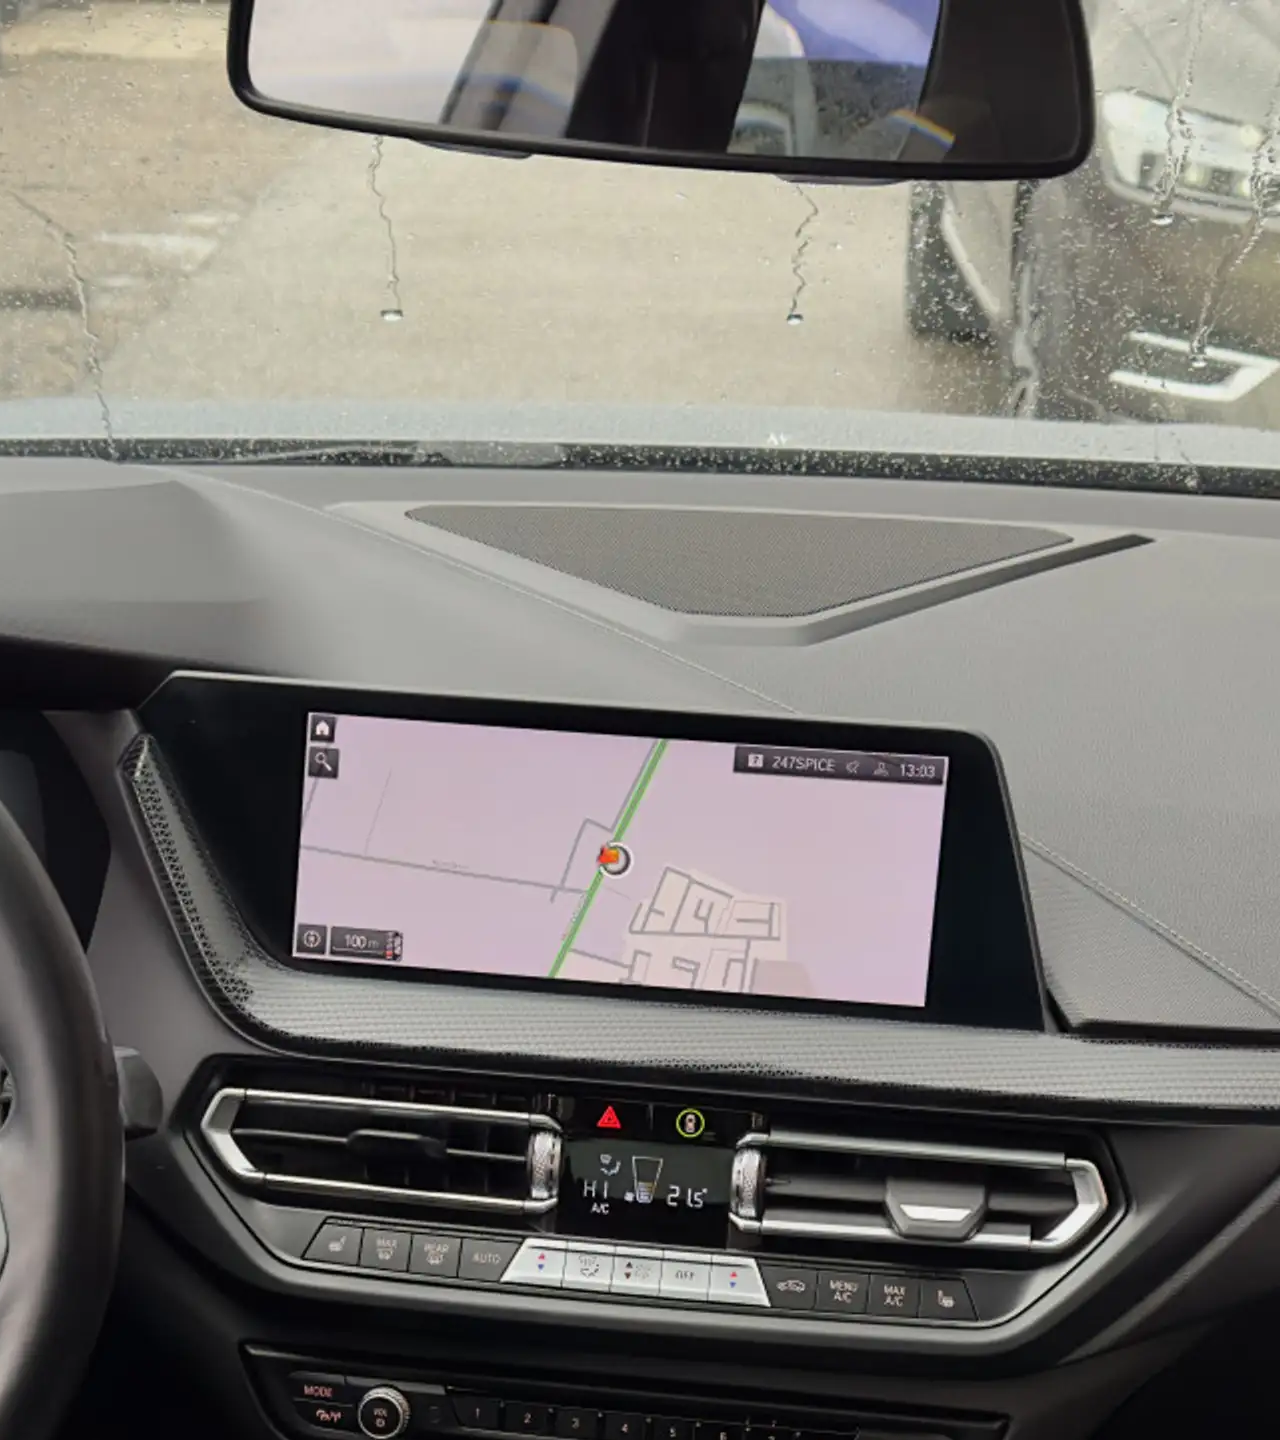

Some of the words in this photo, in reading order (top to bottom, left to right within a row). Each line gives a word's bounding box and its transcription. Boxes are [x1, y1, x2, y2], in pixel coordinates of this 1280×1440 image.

[772, 756, 835, 772] 247SPICE
[899, 763, 935, 778] 13:03
[345, 934, 367, 948] 100
[590, 1202, 610, 1215] A/C
[472, 1253, 501, 1266] AUTO
[883, 1284, 906, 1296] MAX
[304, 1385, 333, 1397] MODE
